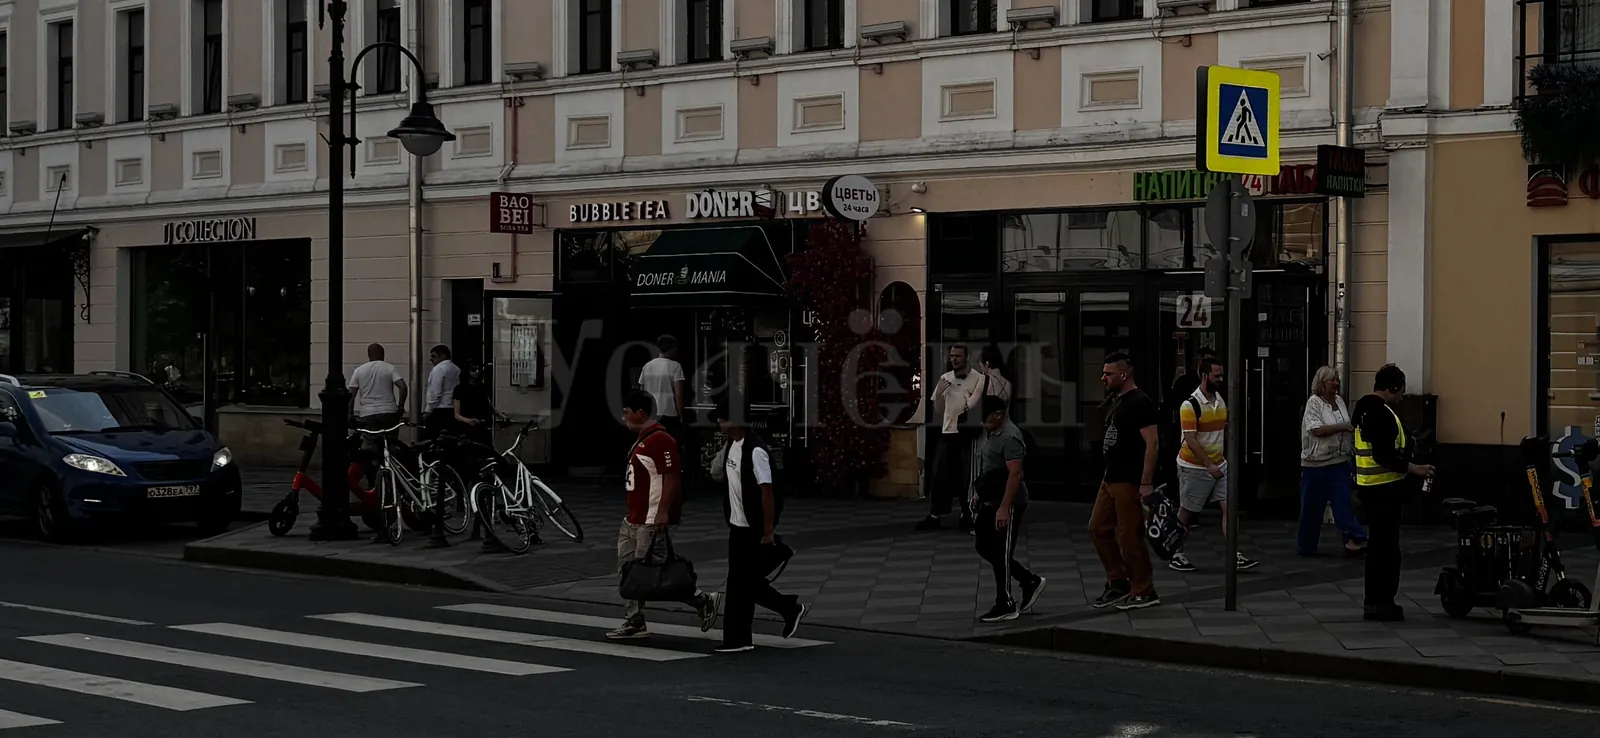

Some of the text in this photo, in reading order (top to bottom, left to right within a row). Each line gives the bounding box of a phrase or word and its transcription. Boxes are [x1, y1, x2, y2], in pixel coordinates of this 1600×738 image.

[1133, 170, 1232, 199] НАПИТК
[1326, 174, 1364, 193] НАПИТКИ
[500, 195, 529, 209] BAO
[835, 187, 876, 202] ЦВЕТЫ
[500, 208, 529, 225] BEI
[569, 200, 669, 222] BUBBLE TEA
[853, 205, 869, 213] часа
[175, 217, 256, 242] COLLECTION
[636, 269, 727, 287] DONER MANIA
[1179, 297, 1208, 326] 24
